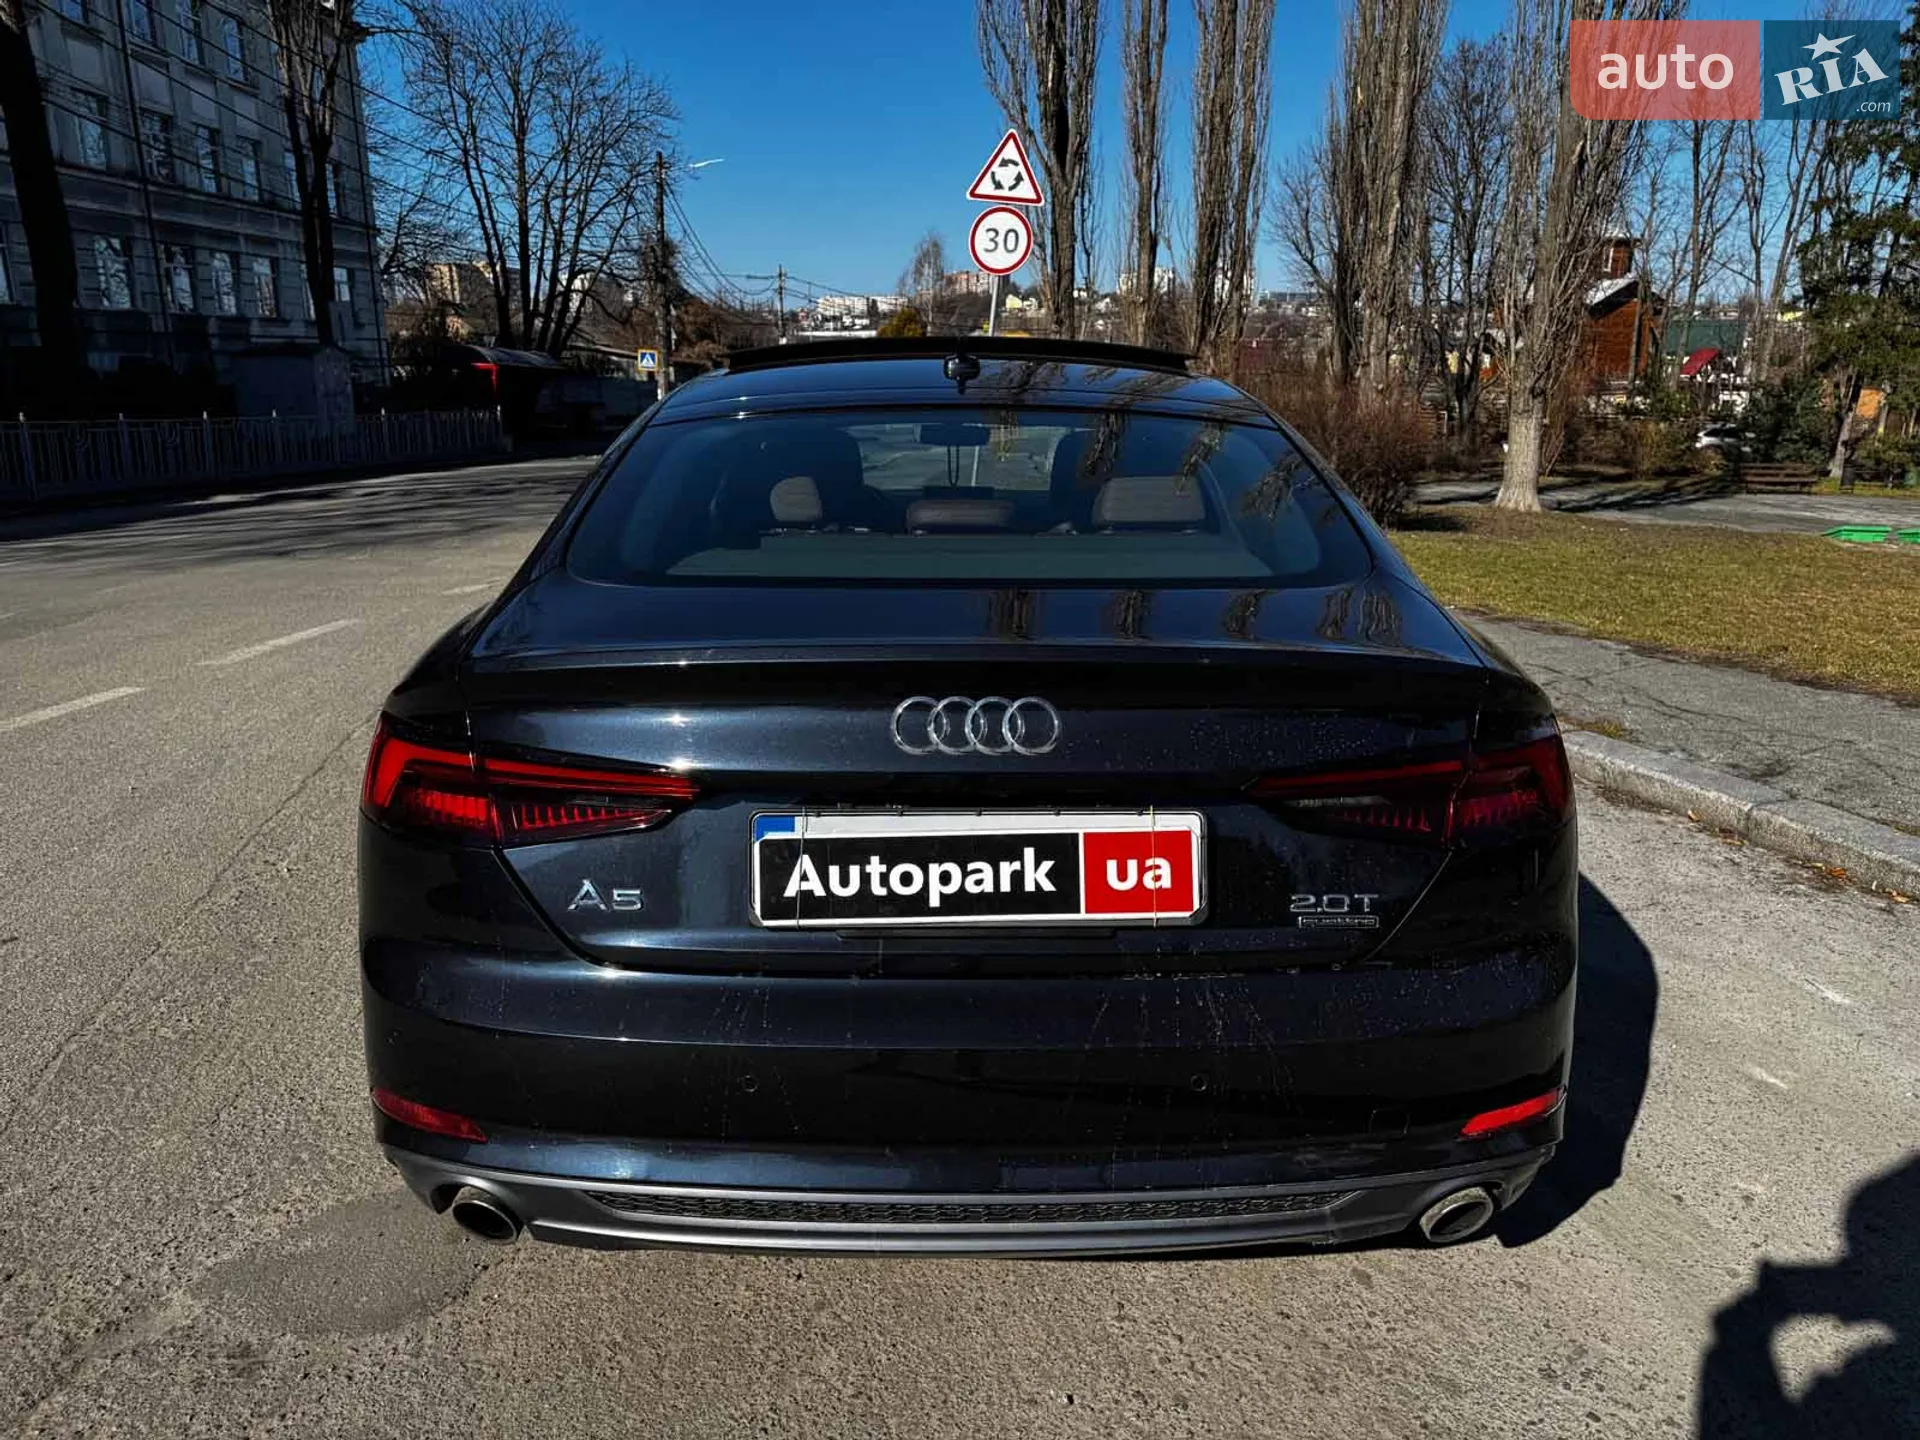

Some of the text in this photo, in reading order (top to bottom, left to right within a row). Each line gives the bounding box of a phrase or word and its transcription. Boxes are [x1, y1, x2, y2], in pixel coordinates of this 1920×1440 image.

[984, 227, 1020, 254] 30
[783, 847, 1172, 907] Autopark ua
[567, 879, 642, 910] A5
